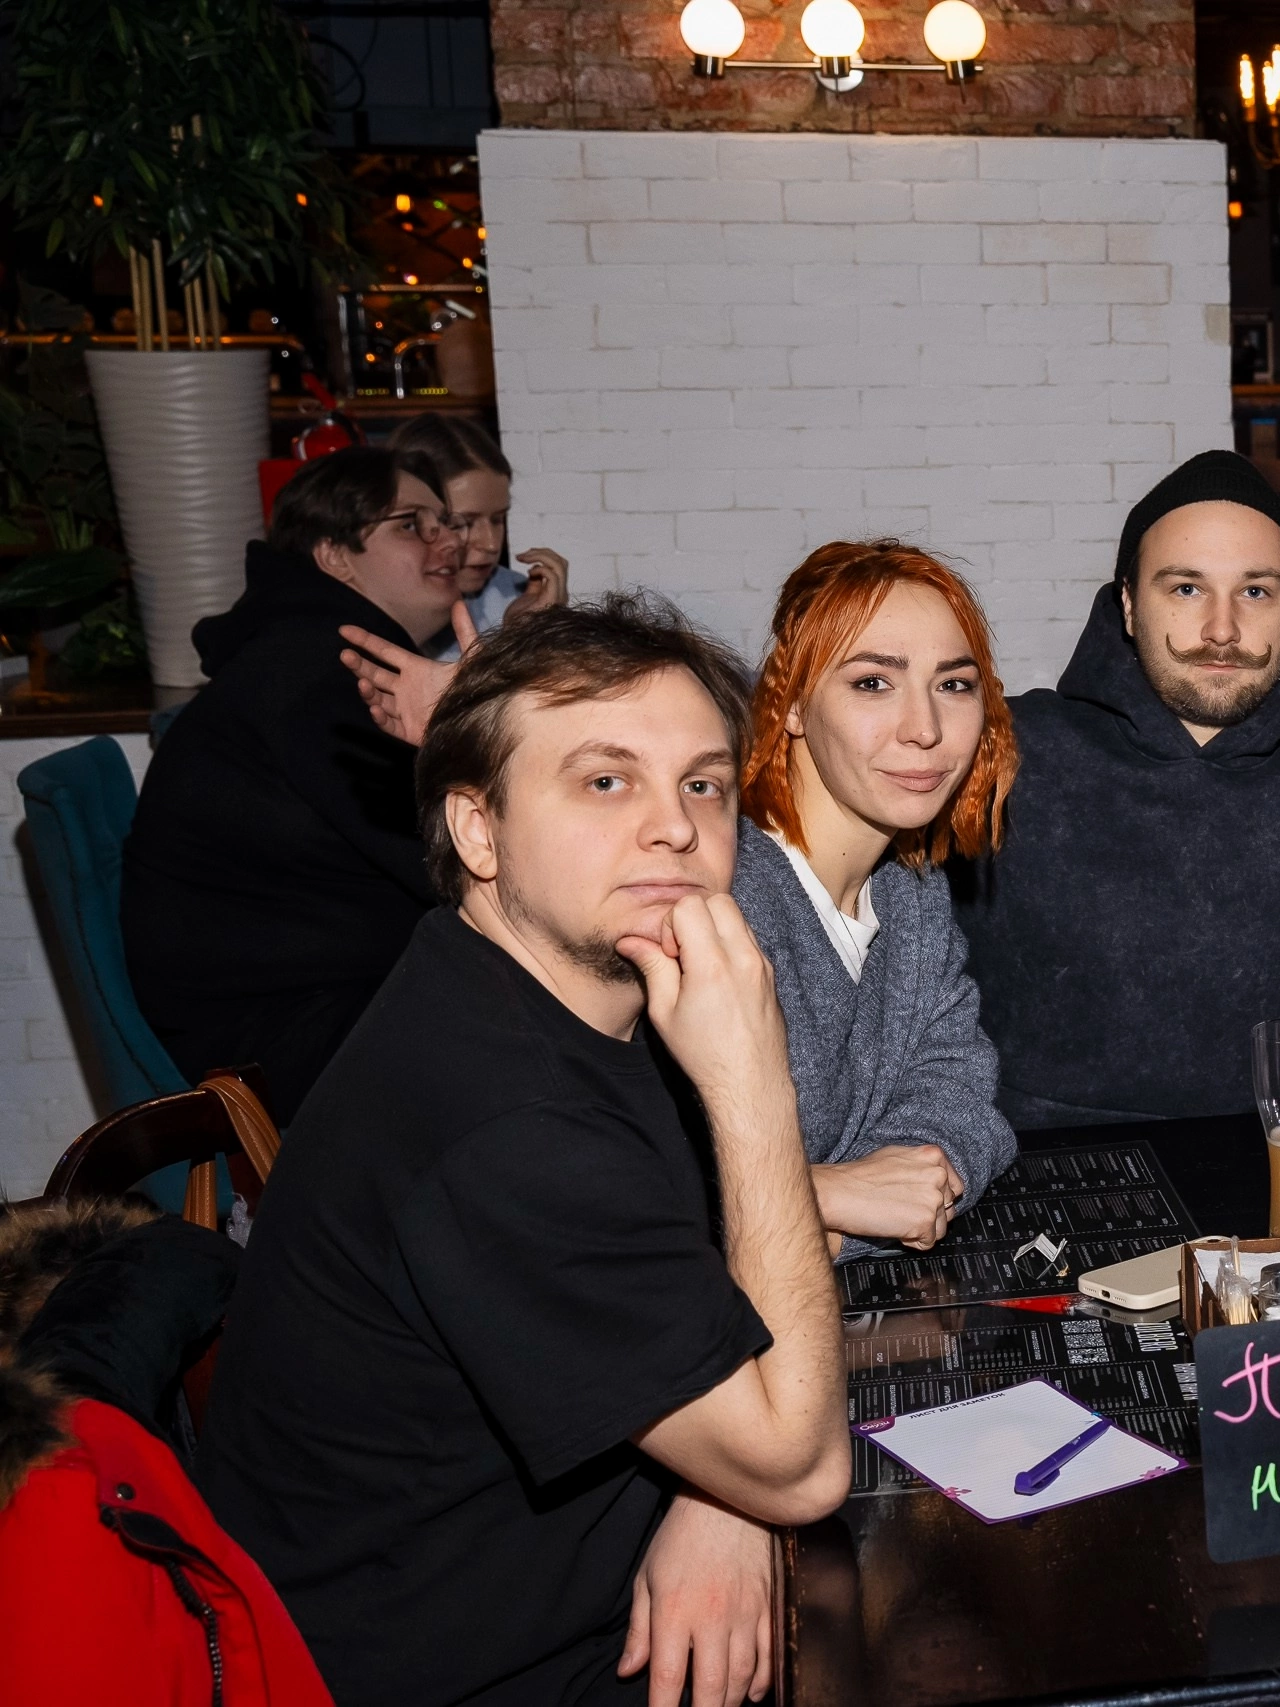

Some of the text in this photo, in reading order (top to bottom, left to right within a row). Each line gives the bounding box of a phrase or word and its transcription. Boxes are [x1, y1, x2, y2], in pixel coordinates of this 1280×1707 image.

[909, 1392, 1006, 1419] ЛИСТ ДЛЯ ЗАМЕТОК
